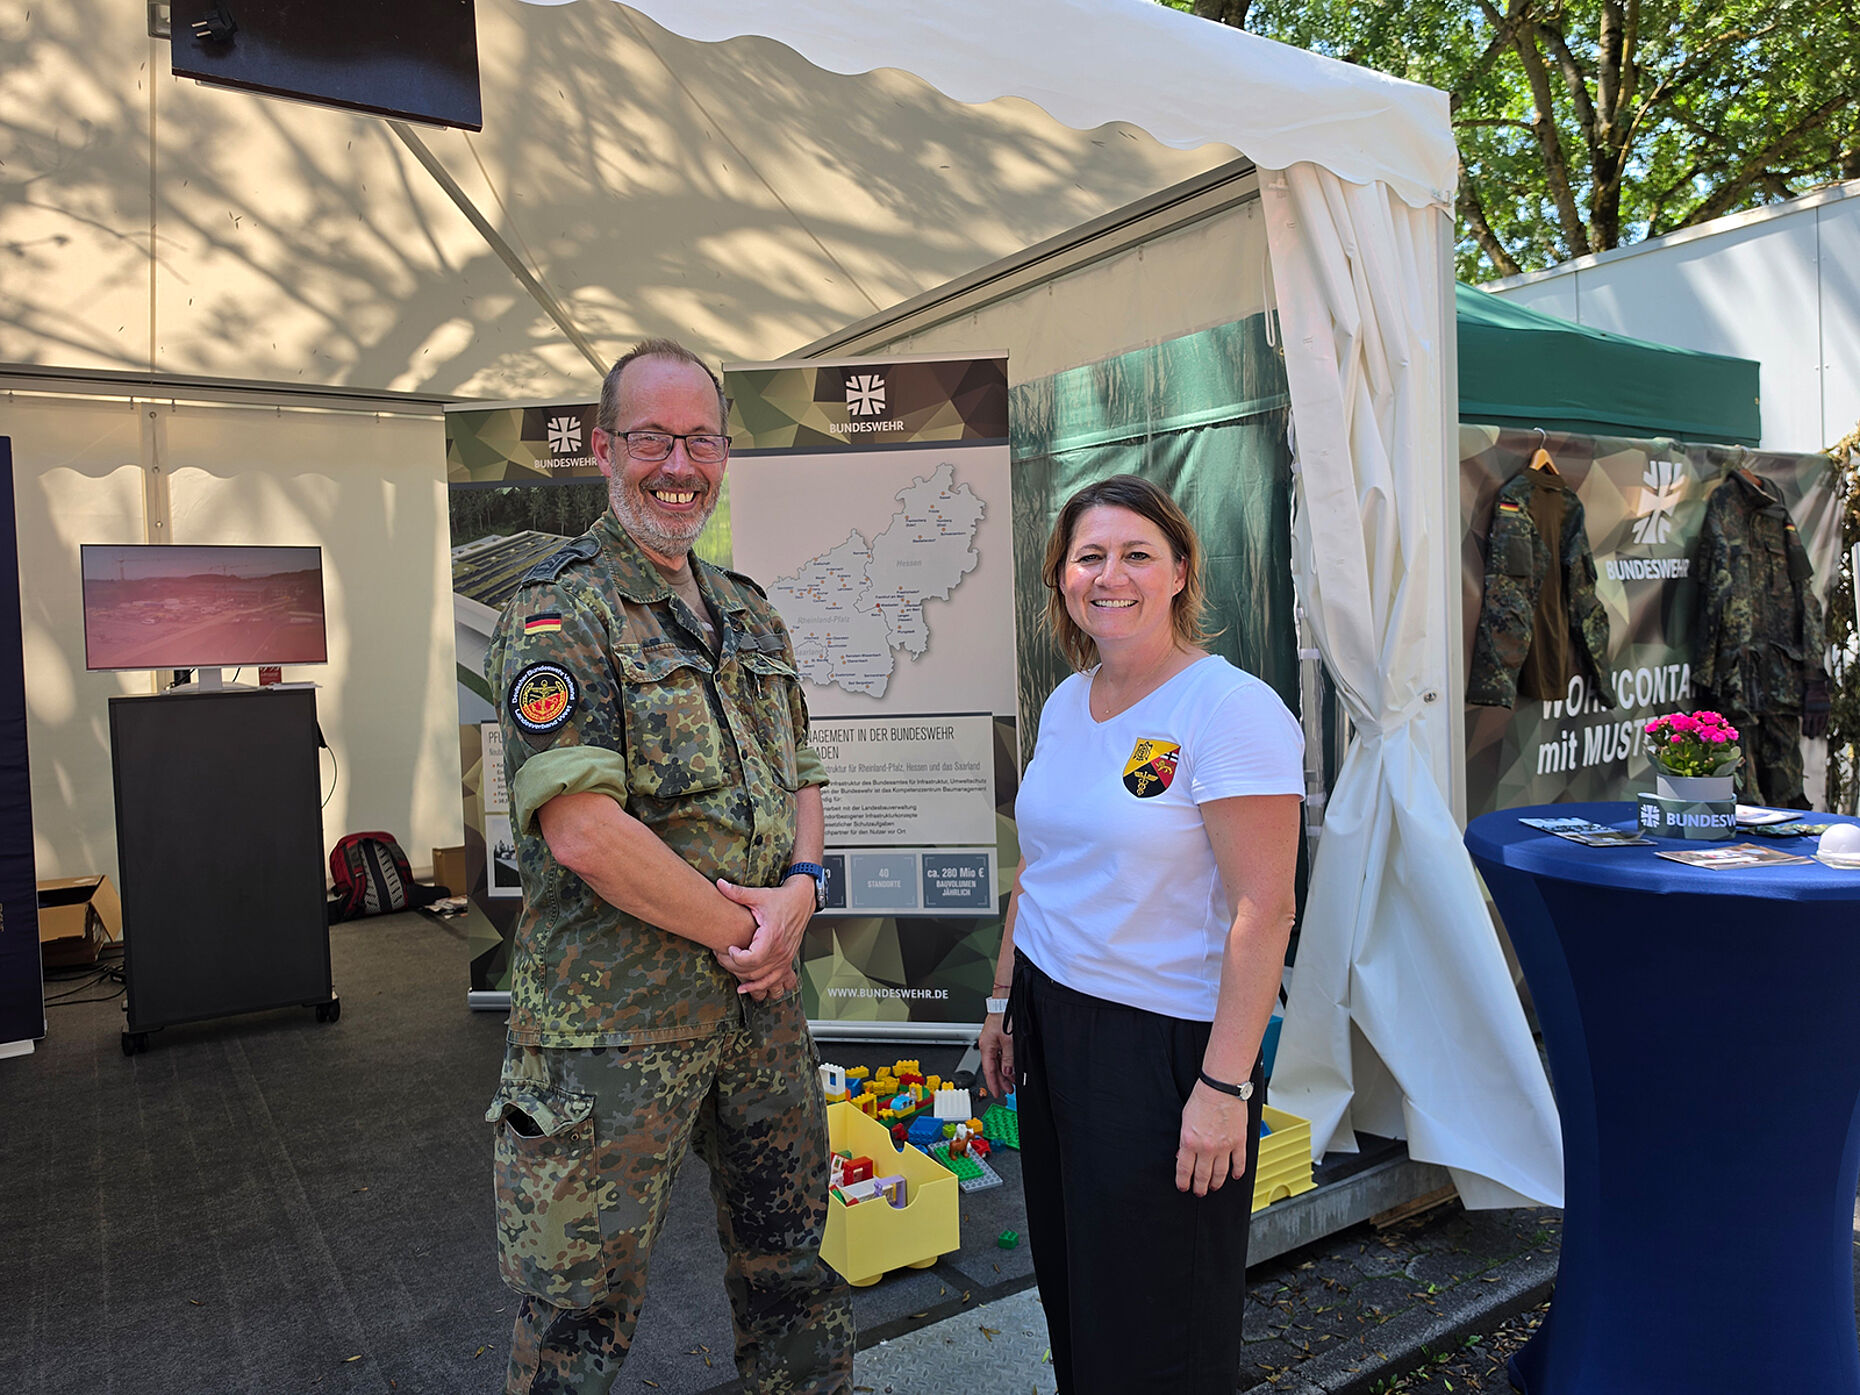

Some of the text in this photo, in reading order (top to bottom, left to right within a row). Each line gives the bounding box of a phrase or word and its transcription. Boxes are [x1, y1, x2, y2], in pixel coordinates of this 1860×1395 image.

[829, 421, 904, 434] BUNDESWEHR
[534, 457, 598, 469] BUNDESWEHR
[1606, 558, 1690, 580] BUNDESWEHR
[857, 728, 867, 742] IN
[870, 728, 888, 742] DER
[890, 726, 955, 741] BUNDESWEHR
[1537, 730, 1578, 775] mit
[929, 761, 941, 771] und
[953, 761, 981, 771] Saarland
[878, 868, 889, 879] 40
[926, 867, 985, 878] ca. 280 Mio €
[867, 880, 902, 888] STANDORTE
[936, 880, 977, 888] BAUVOLUMEN
[827, 987, 949, 999] WWW.BUNDESWEHR.DE
